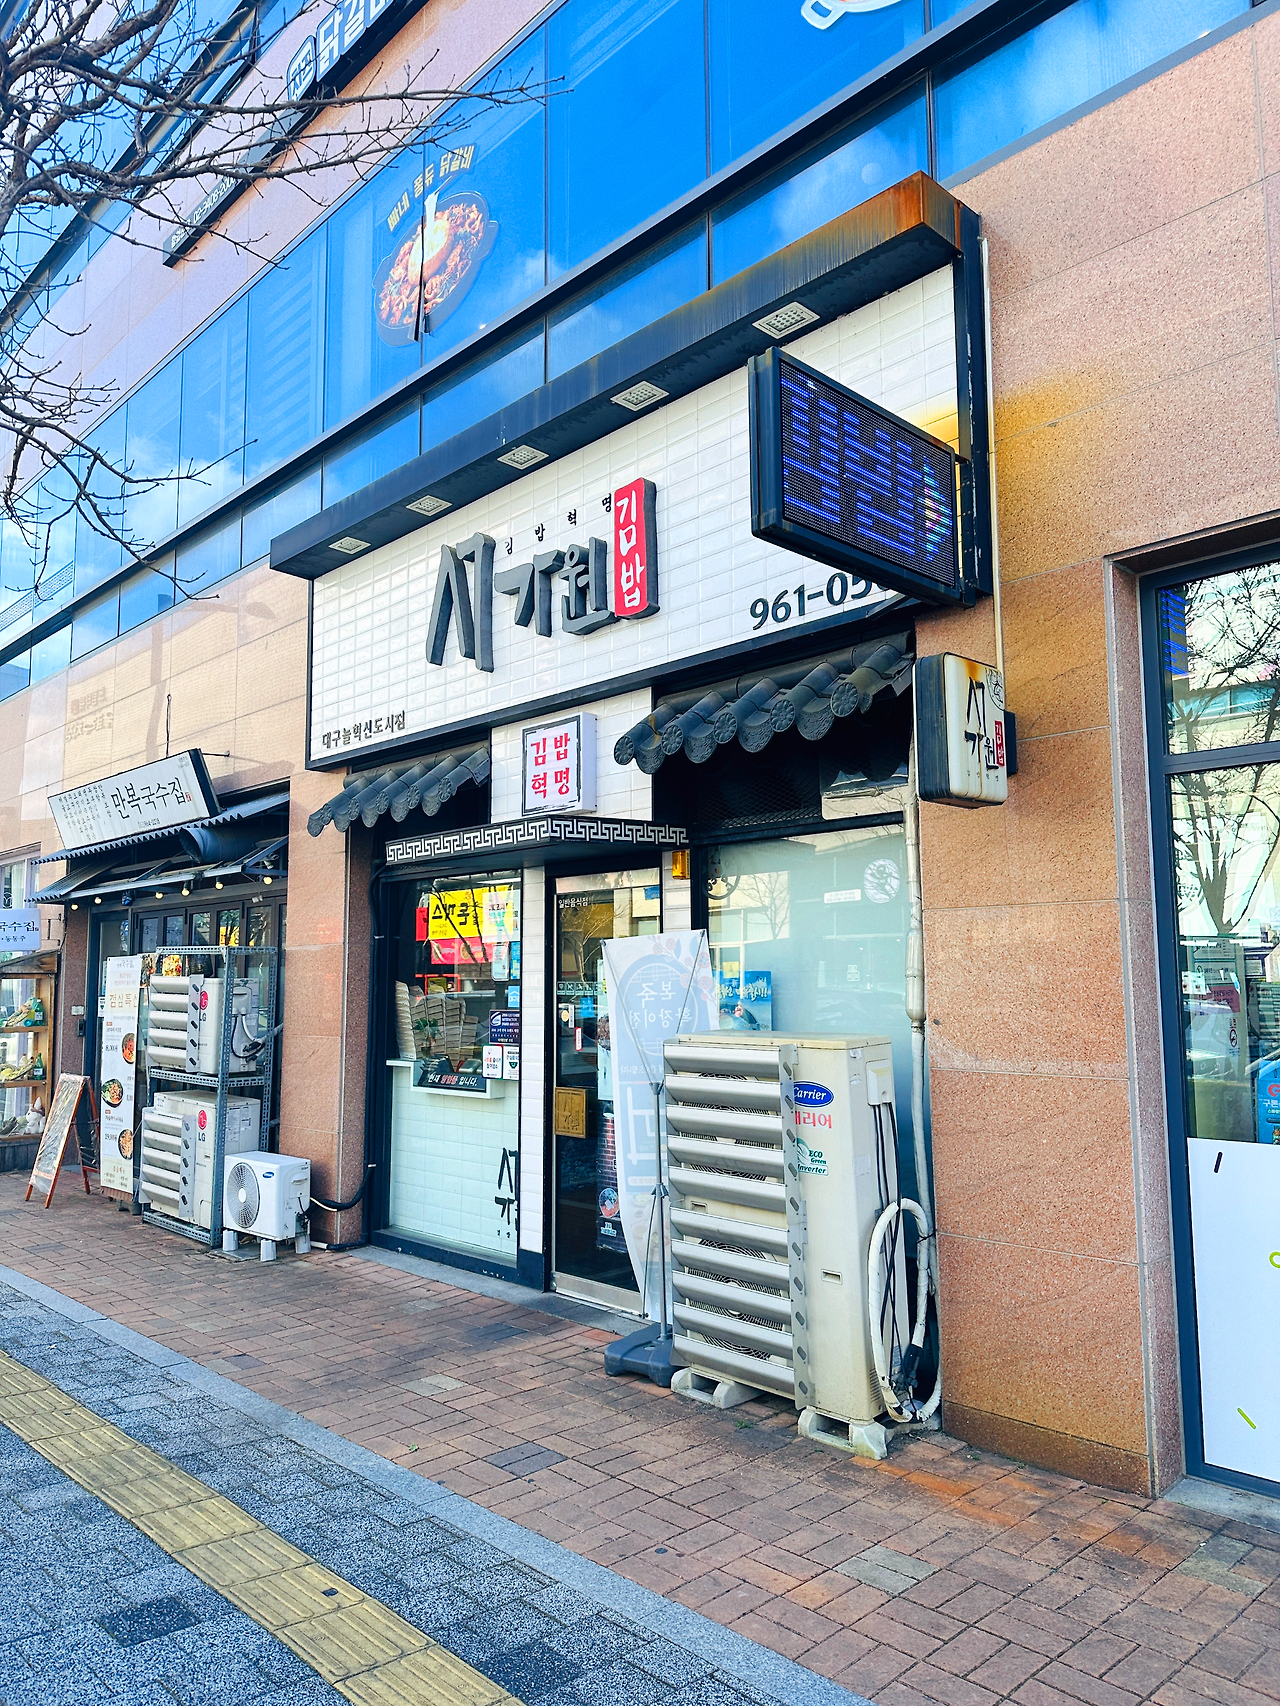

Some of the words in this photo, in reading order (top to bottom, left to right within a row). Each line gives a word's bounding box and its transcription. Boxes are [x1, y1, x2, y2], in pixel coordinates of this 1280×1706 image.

[387, 190, 410, 232] 빠네
[413, 163, 434, 198] 퐁듀
[440, 145, 475, 177] 닭갈비
[616, 489, 645, 608] 김밥
[531, 732, 570, 766] 김밥
[531, 767, 570, 798] 혁명
[110, 777, 187, 820] 만복국수집
[794, 1086, 827, 1101] Carrier
[198, 1132, 206, 1142] LG
[797, 1163, 827, 1174] Inverter
[808, 1150, 823, 1159] ECO
